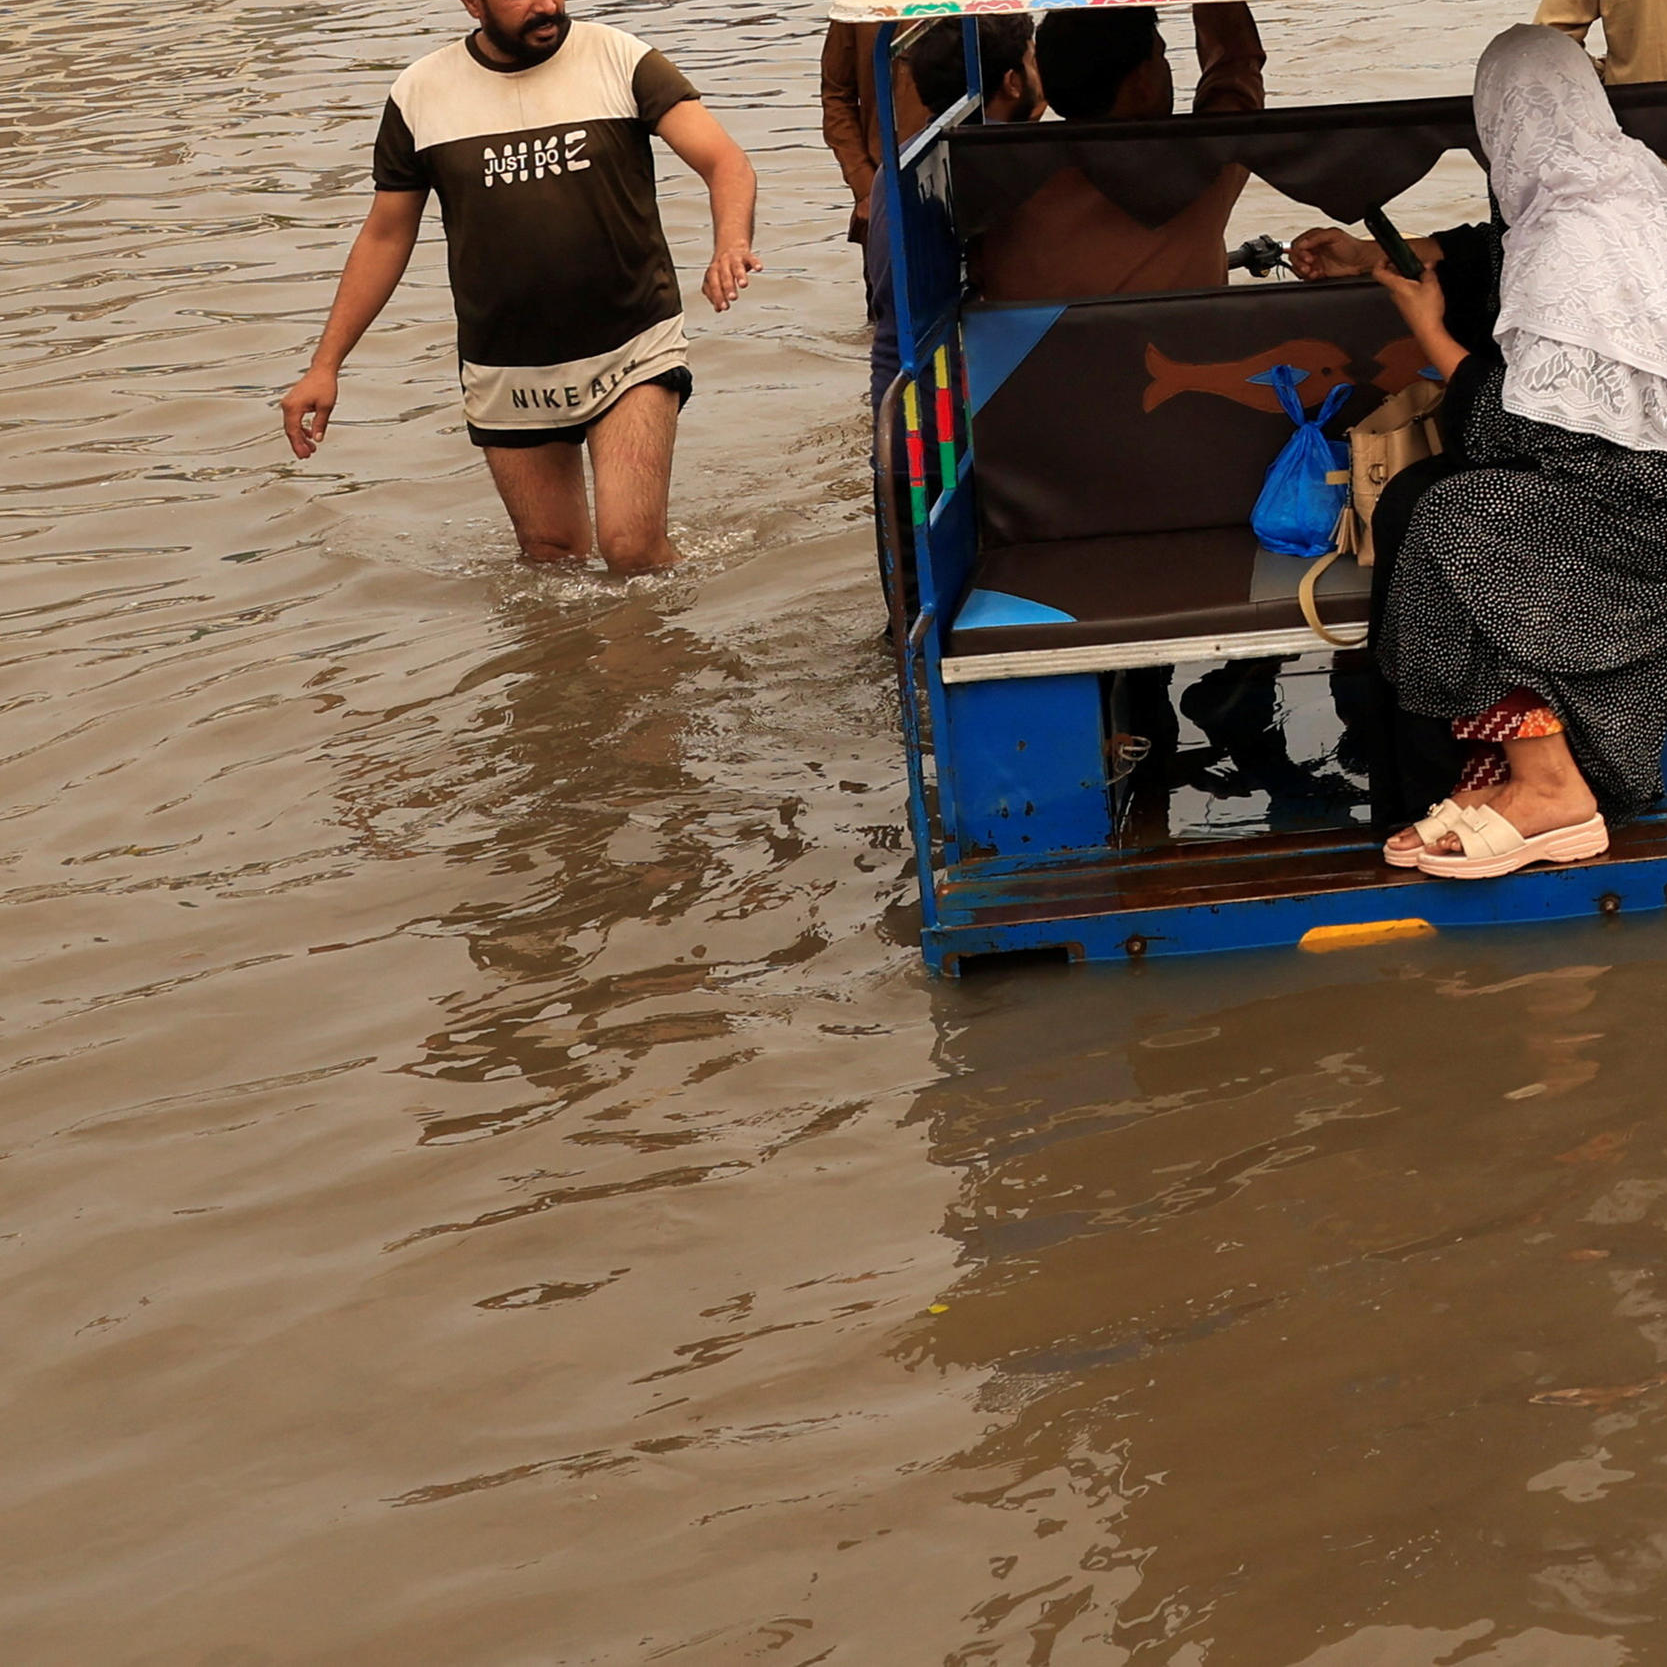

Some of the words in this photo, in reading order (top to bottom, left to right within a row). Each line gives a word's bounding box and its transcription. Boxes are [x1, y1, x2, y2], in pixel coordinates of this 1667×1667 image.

[484, 130, 591, 187] NIKE
[484, 154, 529, 174] JUST
[535, 149, 559, 167] DO
[512, 386, 582, 409] NIKE
